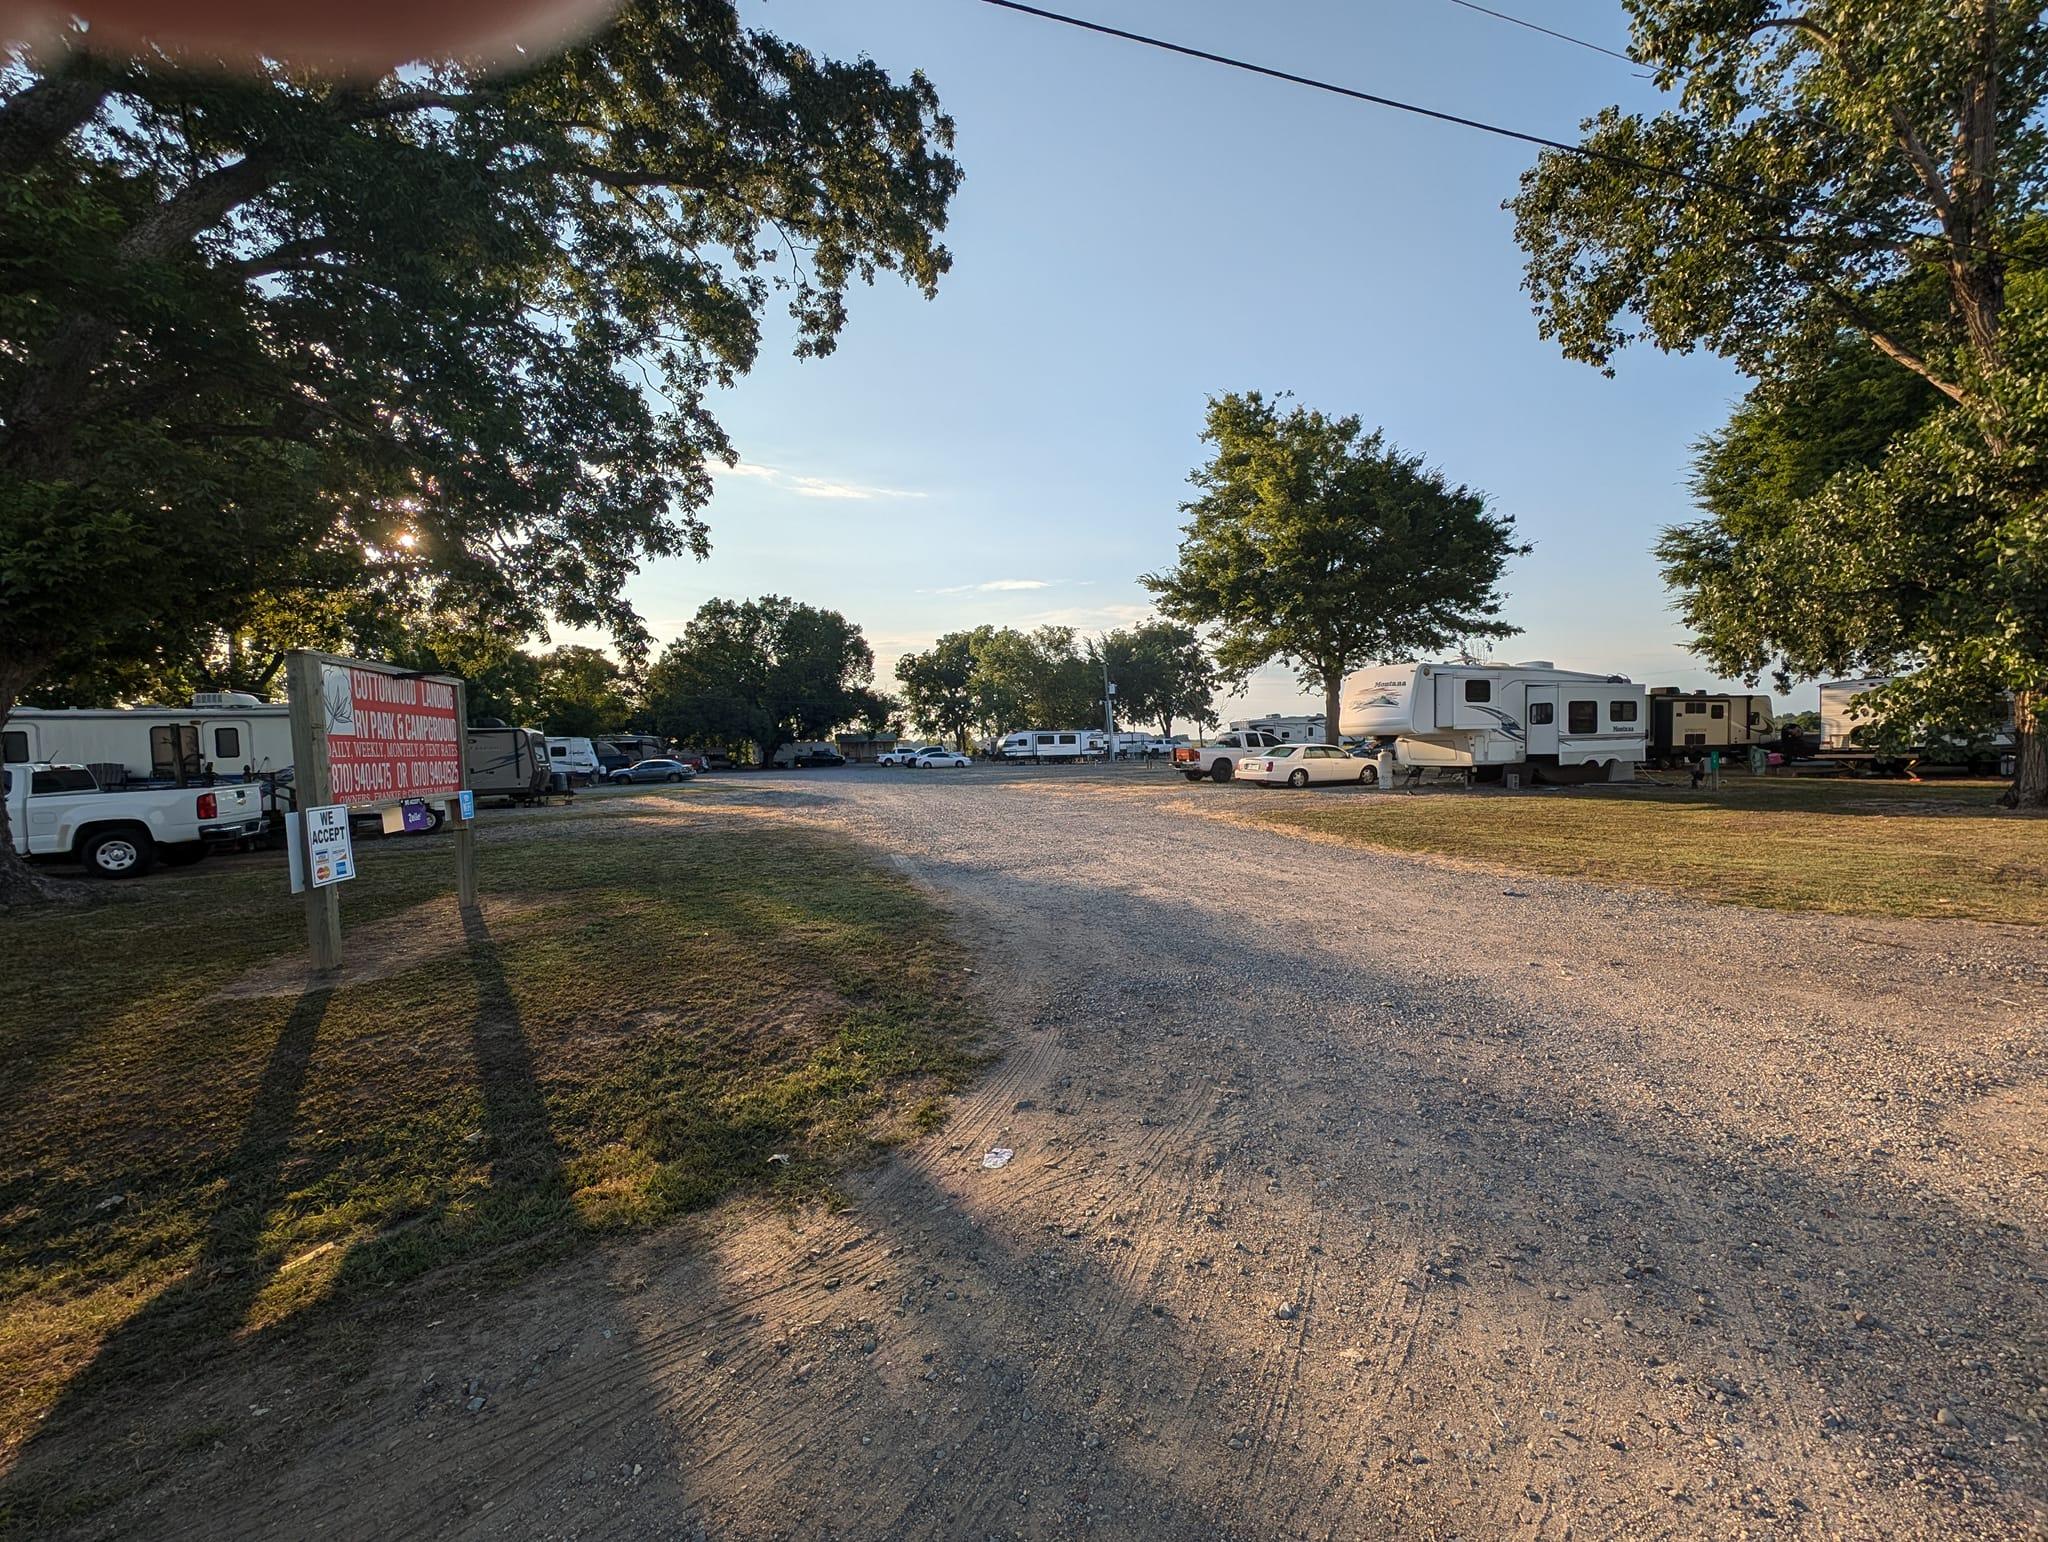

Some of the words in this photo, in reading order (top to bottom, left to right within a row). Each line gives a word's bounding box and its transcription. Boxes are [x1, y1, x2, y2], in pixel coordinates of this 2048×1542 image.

[353, 670, 417, 706] COTTONWOOD
[420, 681, 454, 710] LANDING
[354, 709, 369, 739] RV
[370, 711, 396, 740] PARK
[397, 713, 405, 740] &
[405, 714, 457, 742] CAMPGROUND
[353, 741, 387, 759] WEEKLY,
[386, 742, 419, 757] MONTHLY
[425, 743, 440, 757] TENT
[441, 744, 458, 757] RATES
[331, 762, 353, 794] 870)
[354, 762, 392, 792] 940-0475
[396, 762, 409, 788] OR
[411, 761, 429, 788] (870)
[429, 761, 460, 786] 940-0525
[320, 811, 334, 826] WE
[312, 826, 345, 845] ACCEPT
